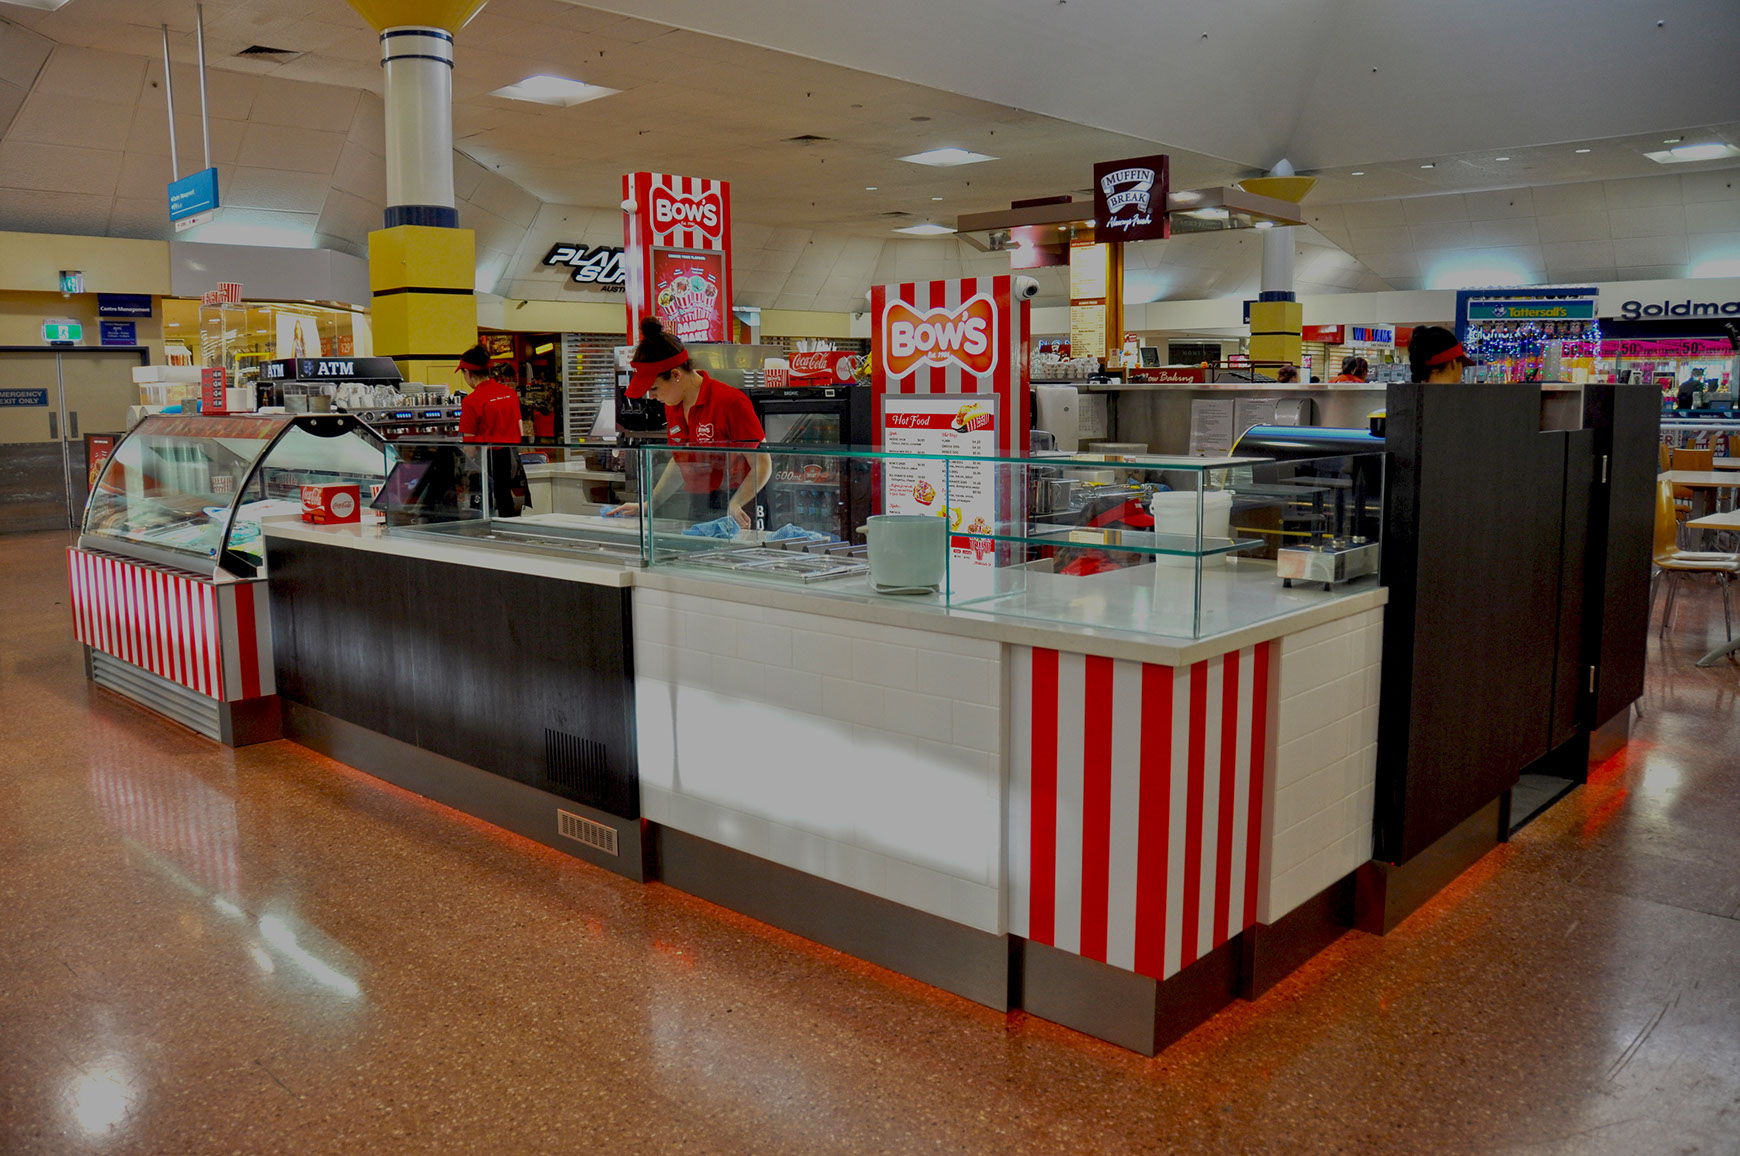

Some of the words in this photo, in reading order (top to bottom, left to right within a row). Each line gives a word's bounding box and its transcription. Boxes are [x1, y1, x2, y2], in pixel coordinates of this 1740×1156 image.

[1106, 169, 1150, 186] MUFFIN
[1110, 193, 1147, 206] BREAK
[656, 198, 717, 227] BOW'S
[117, 306, 150, 314] Management
[1508, 307, 1567, 317] Tattersall's
[891, 310, 988, 357] BOW'S
[1352, 326, 1393, 343] WILLIAMS
[267, 364, 284, 378] ATM
[317, 362, 354, 375] ATM
[1158, 370, 1195, 384] Baking
[892, 412, 909, 426] Hot
[908, 414, 931, 428] Food
